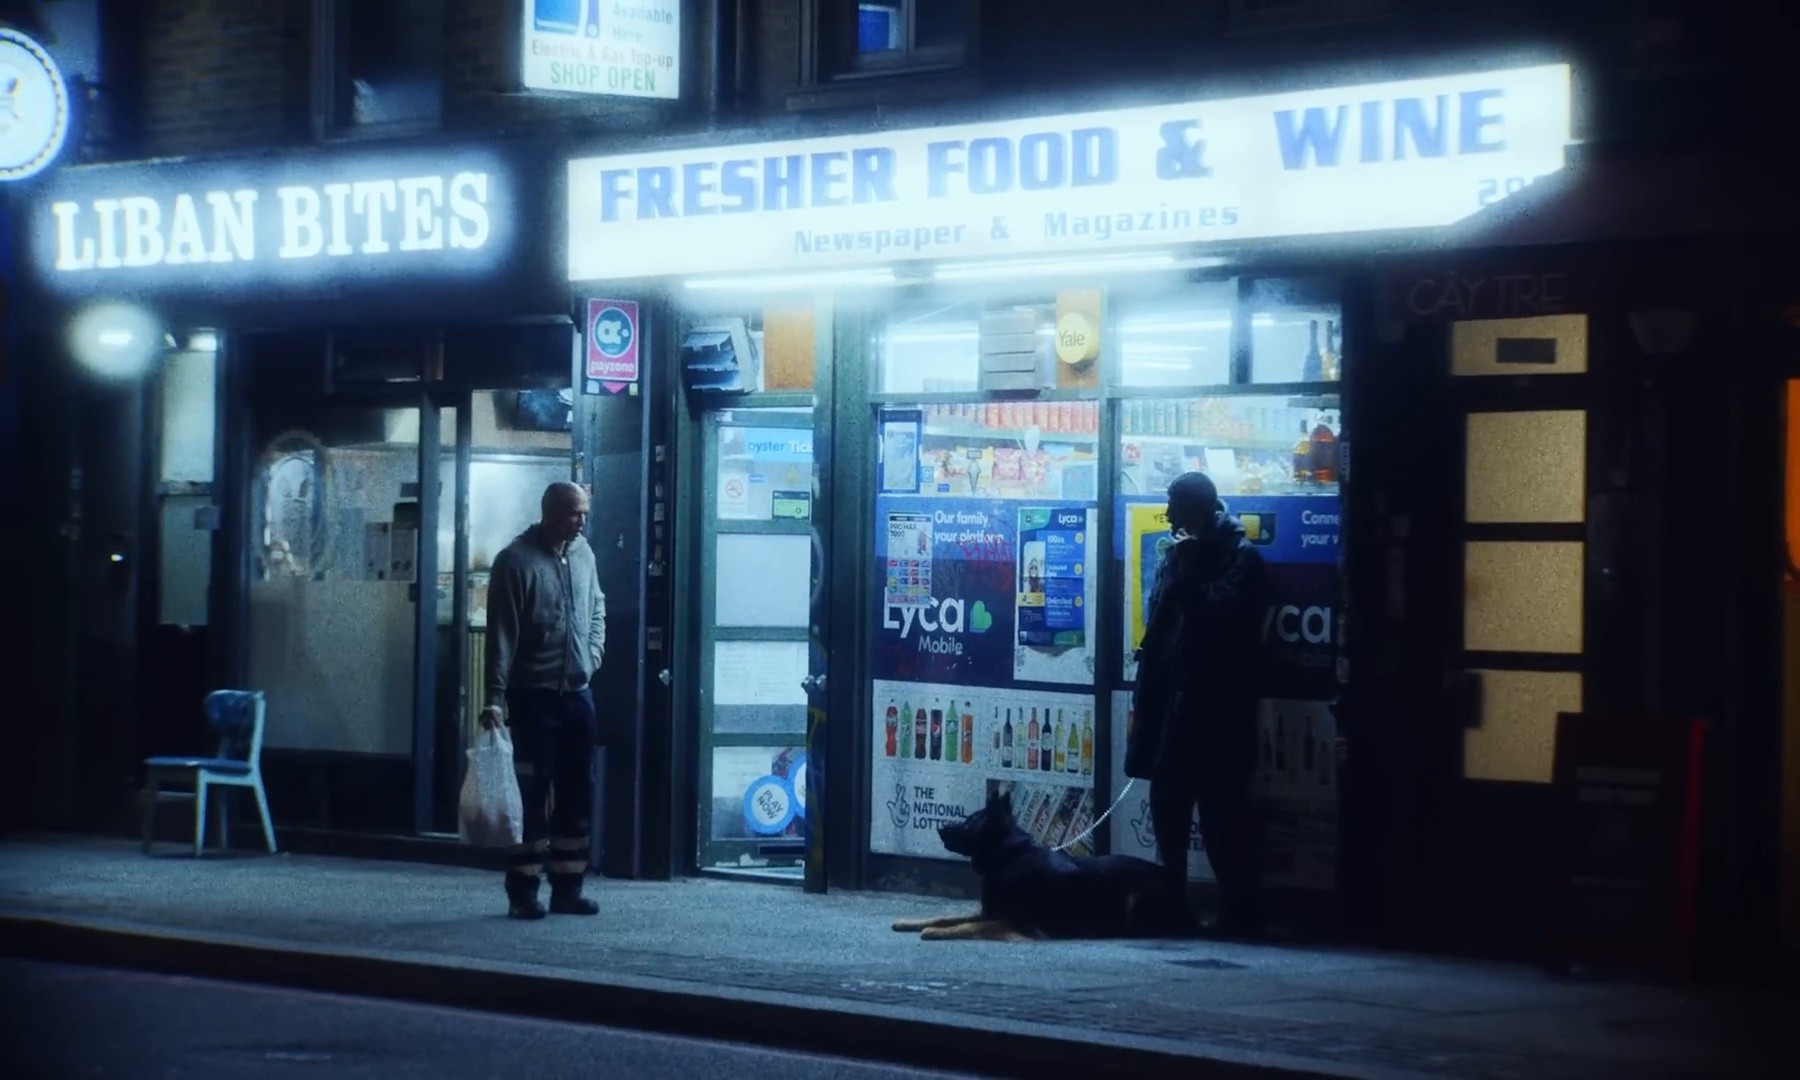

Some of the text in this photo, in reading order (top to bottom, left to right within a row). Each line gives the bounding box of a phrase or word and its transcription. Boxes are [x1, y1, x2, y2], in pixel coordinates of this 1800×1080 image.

[613, 3, 674, 24] Available
[532, 39, 674, 72] Electric & Gas Top-up
[550, 61, 656, 92] SHOP OPEN
[600, 88, 1507, 223] FRESHER FOOD & WINE
[53, 172, 490, 272] LIBAN BITES
[794, 202, 1239, 254] Newspaper & Magazines
[1058, 329, 1085, 347] Yale
[590, 361, 635, 374] payzone
[748, 440, 785, 454] oyster
[935, 510, 955, 524] Our
[1058, 513, 1078, 525] Lyca
[934, 532, 957, 545] your
[1301, 534, 1330, 548] your
[883, 587, 965, 639] Lyca
[918, 635, 963, 655] Mobile
[763, 789, 783, 813] PLAY
[913, 786, 935, 800] THE
[757, 796, 777, 819] NOW
[913, 801, 968, 818] NATIONAL
